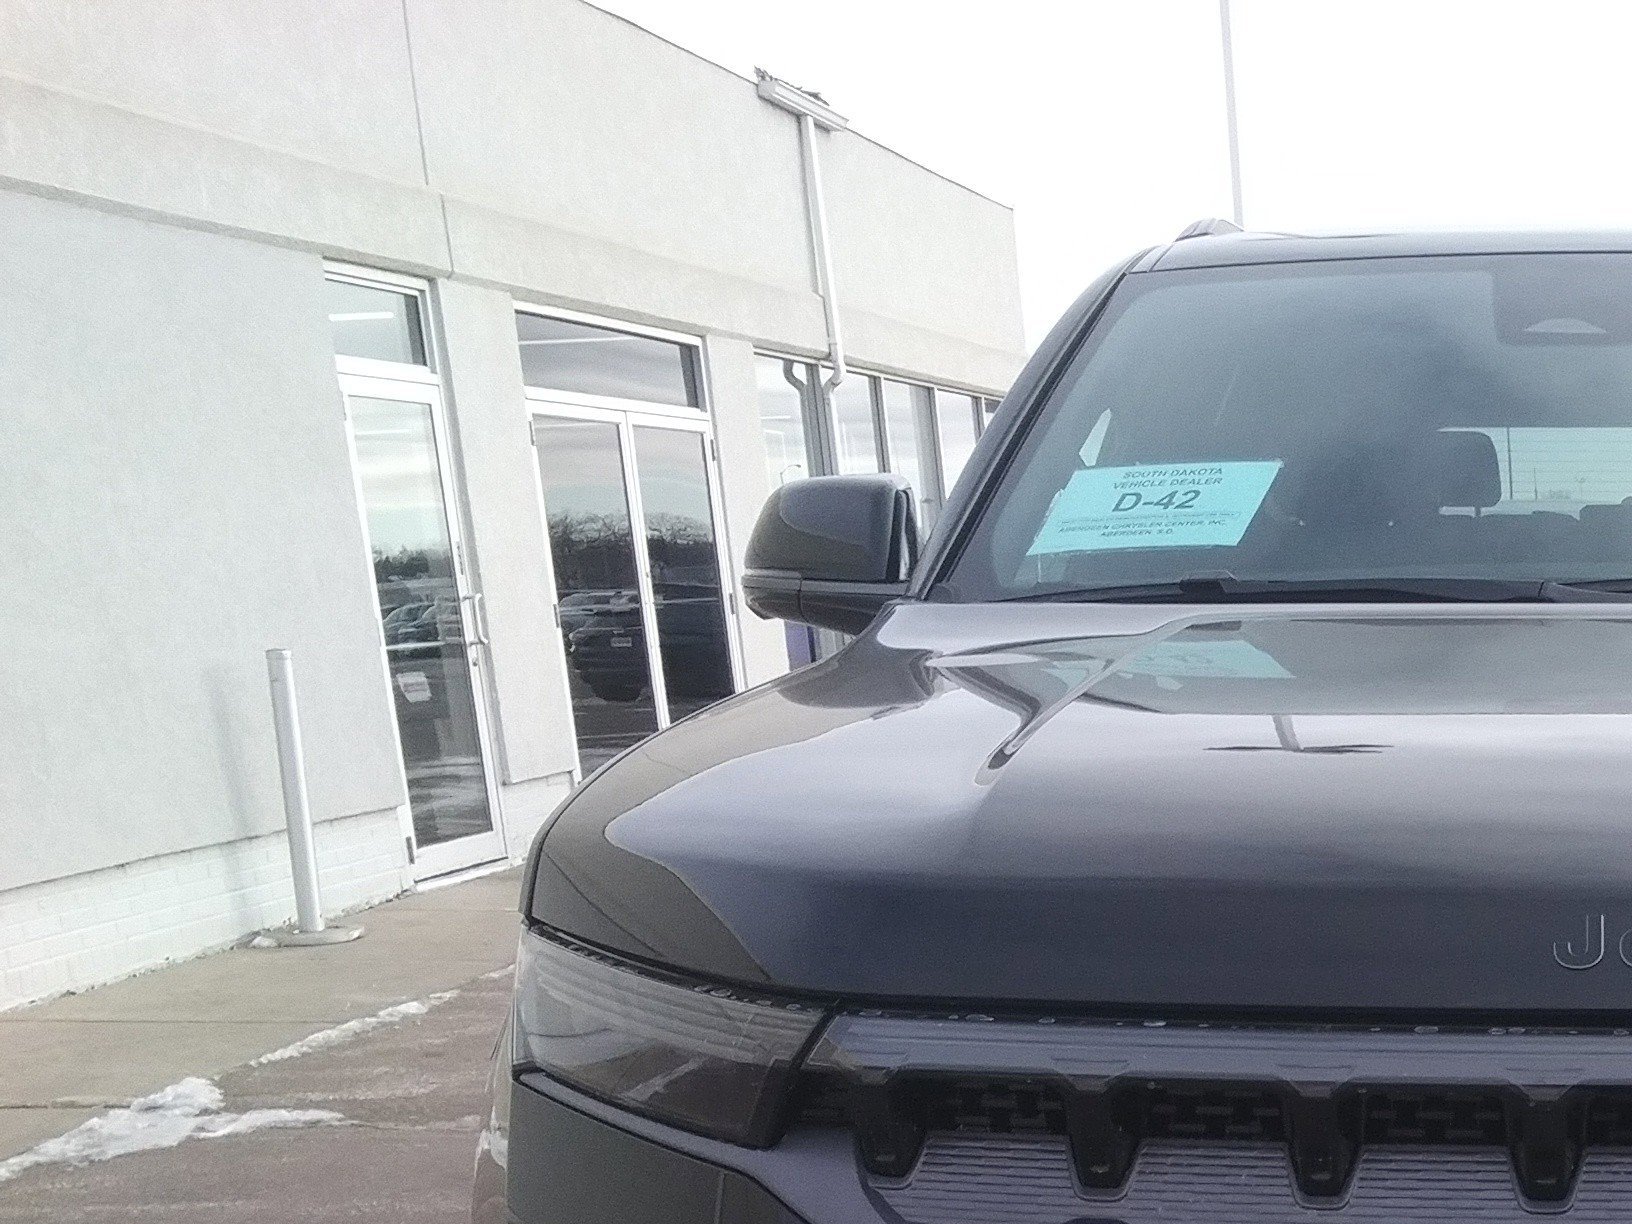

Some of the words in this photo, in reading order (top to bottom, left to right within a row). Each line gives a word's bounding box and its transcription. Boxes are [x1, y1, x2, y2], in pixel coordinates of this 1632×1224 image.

[1123, 469, 1168, 479] SOUTH
[1170, 467, 1223, 477] DAKOTA
[1113, 480, 1167, 490] VEHICLE
[1169, 477, 1223, 486] DEALER
[1111, 489, 1202, 512] D-42
